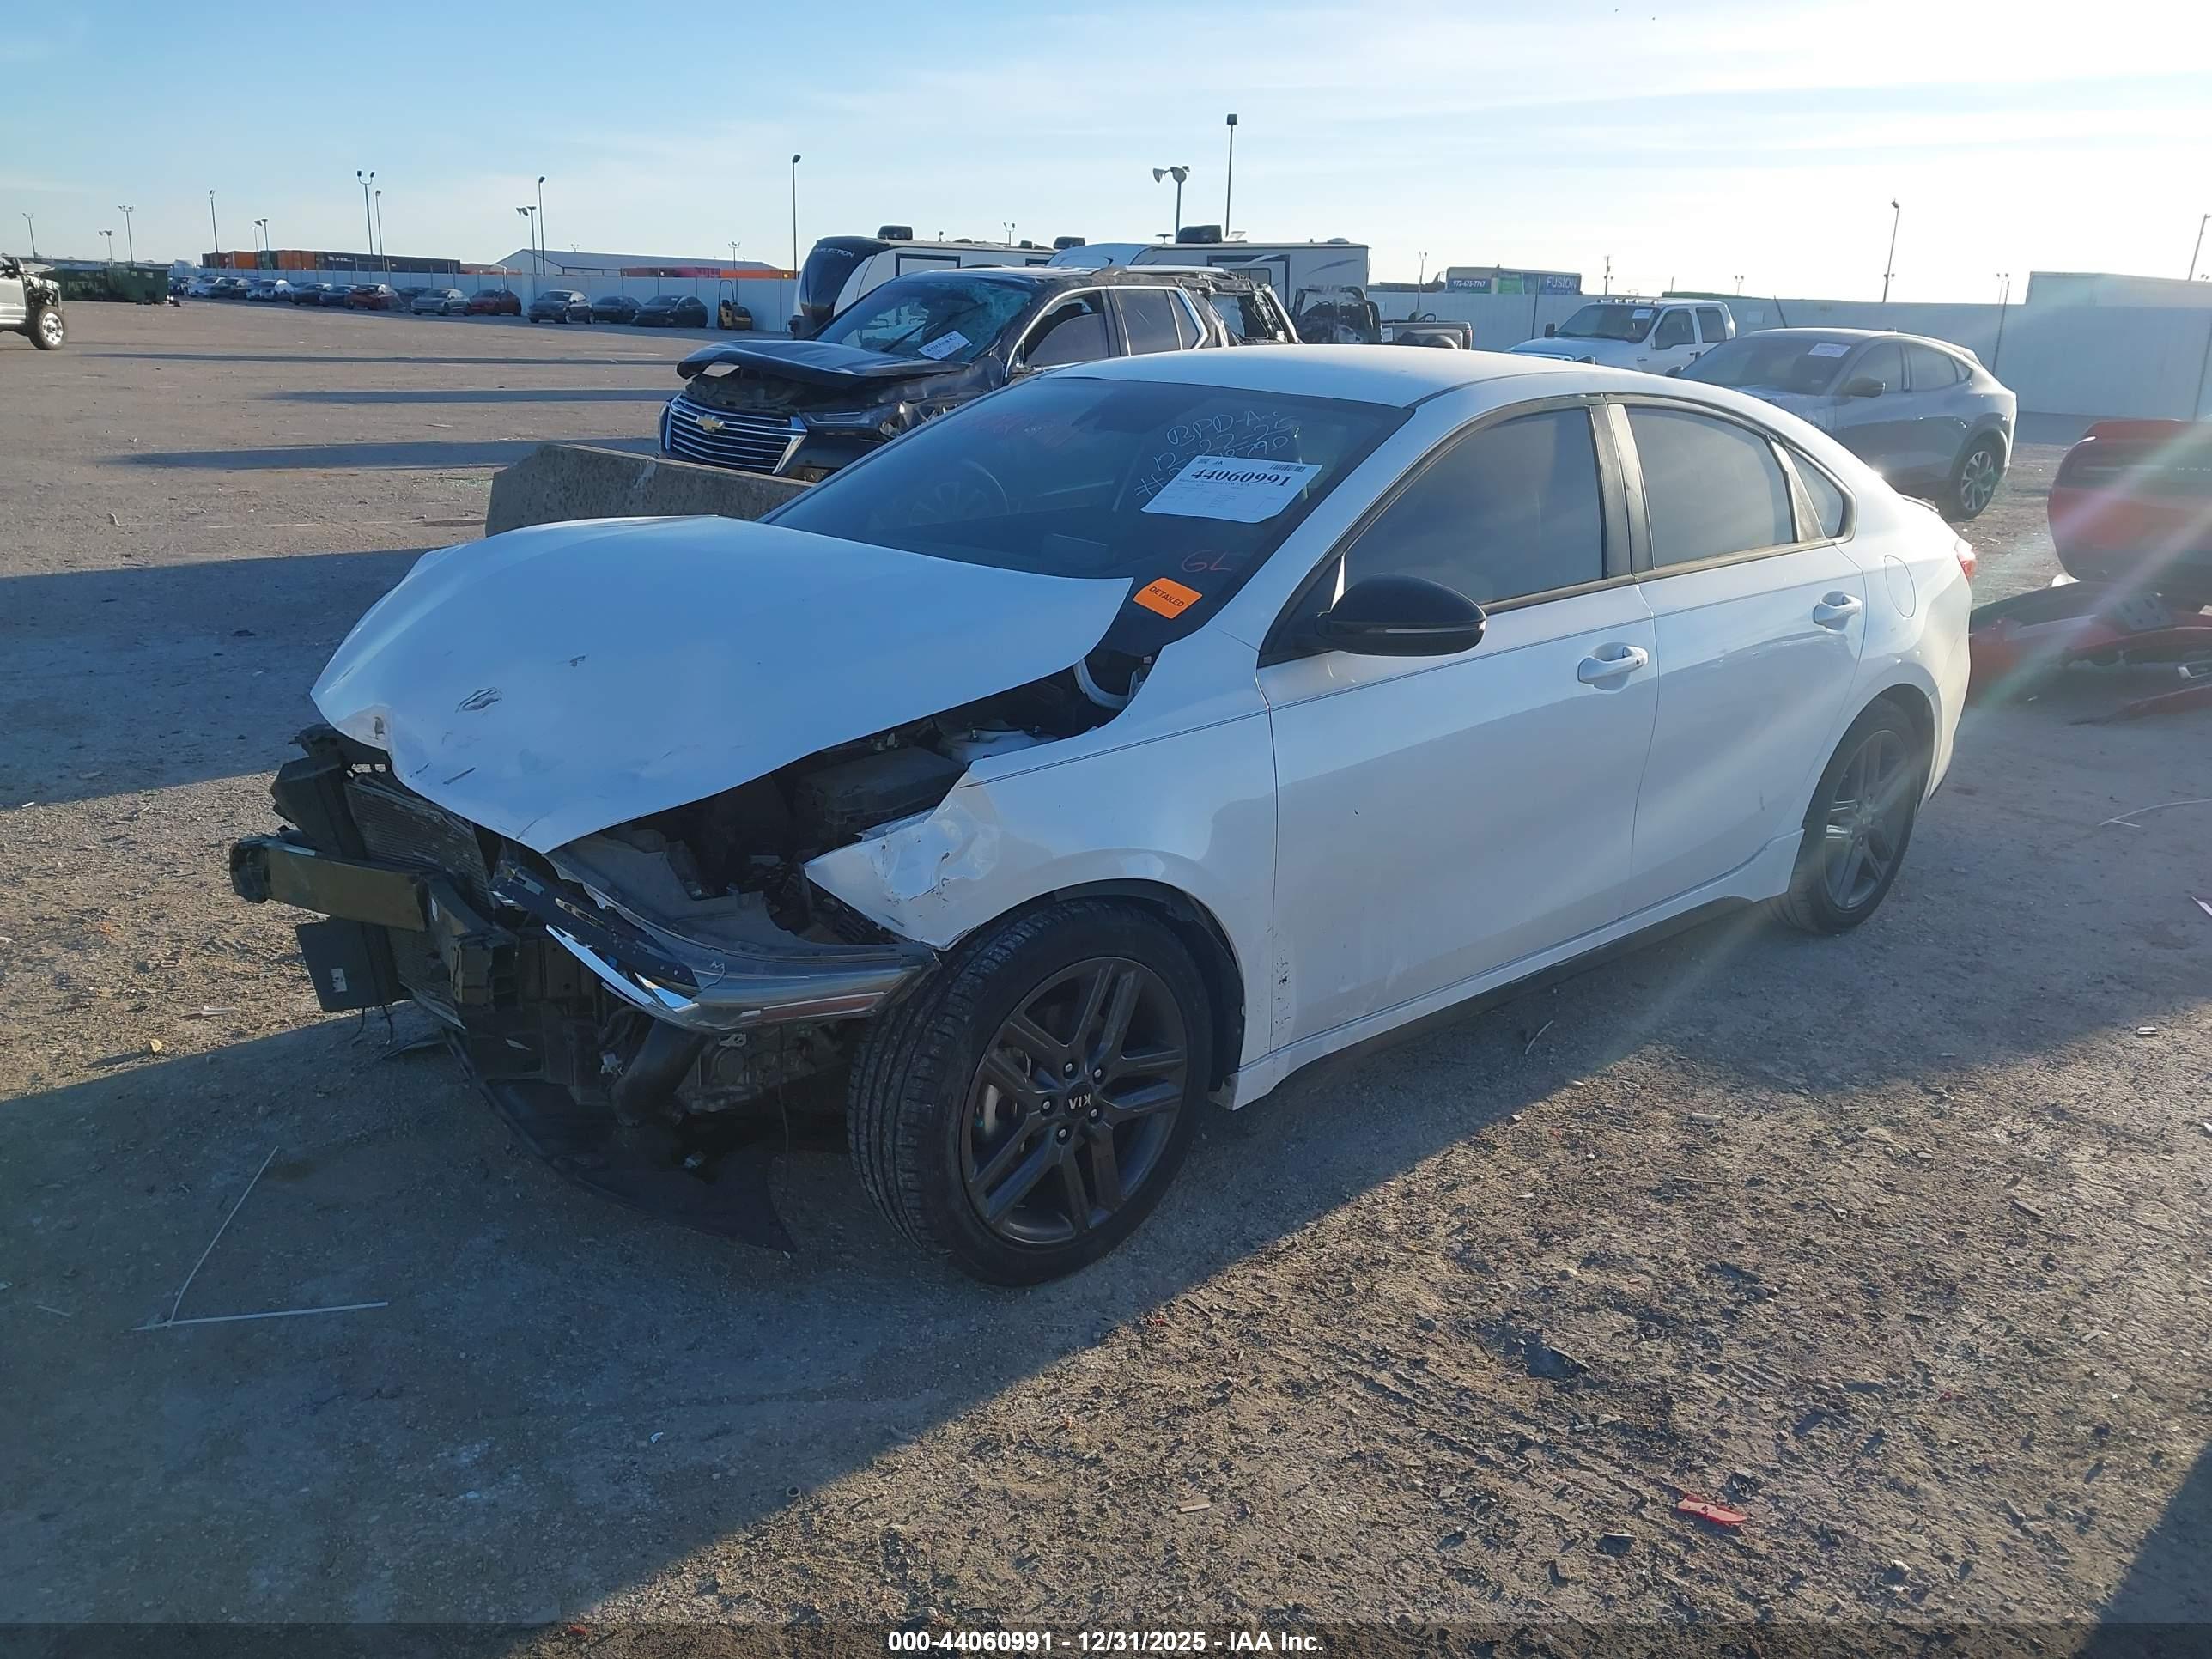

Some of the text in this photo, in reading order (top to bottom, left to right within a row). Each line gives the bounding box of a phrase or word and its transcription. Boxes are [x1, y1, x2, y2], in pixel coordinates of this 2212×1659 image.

[1547, 275, 1577, 289] FUSION
[1191, 469, 1292, 487] 44060991
[1149, 586, 1185, 608] DETAILED
[1068, 1093, 1091, 1109] KIA
